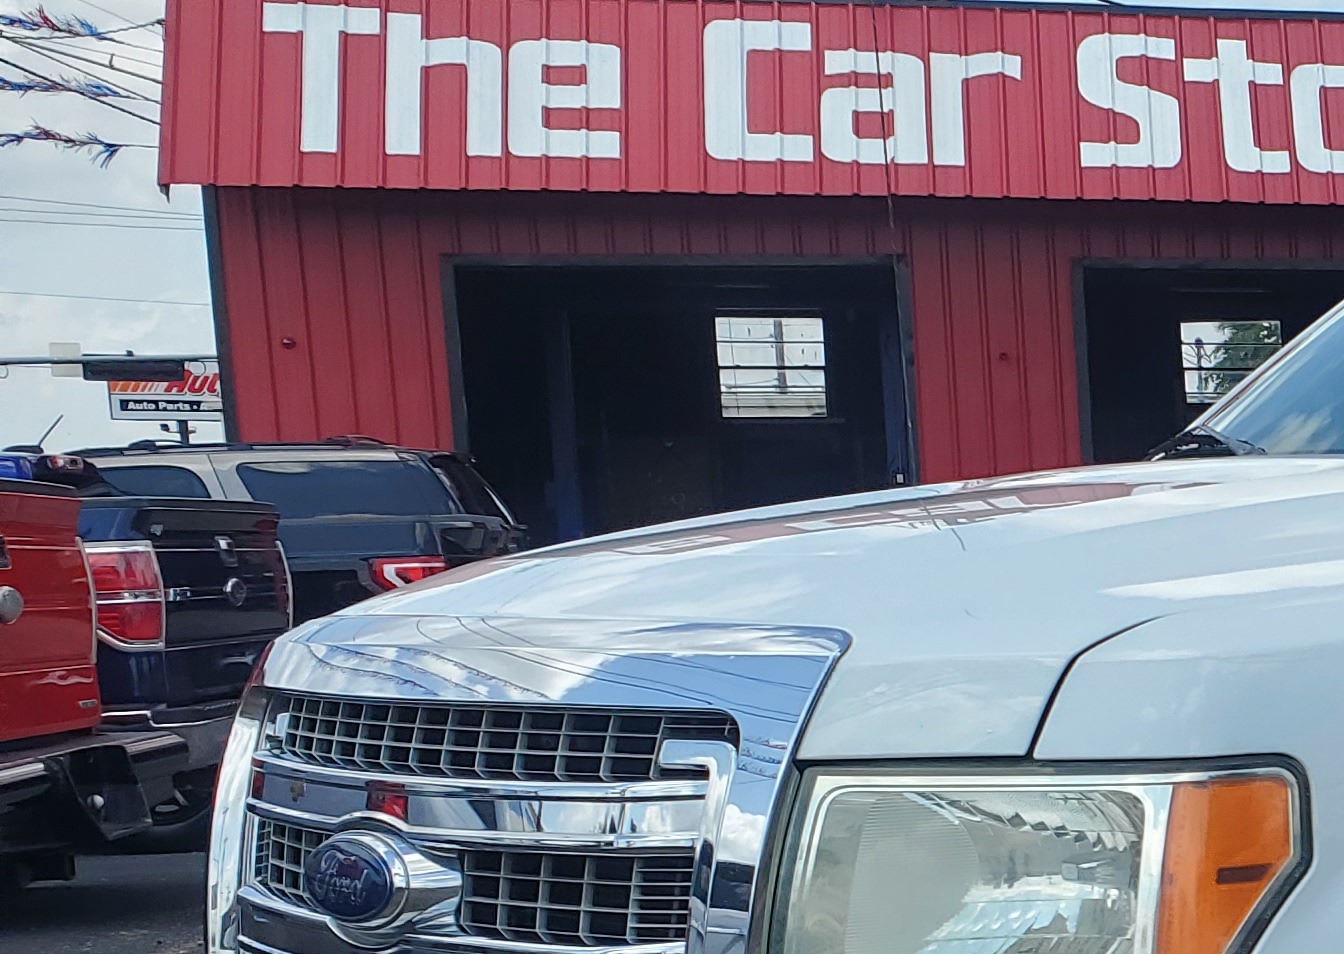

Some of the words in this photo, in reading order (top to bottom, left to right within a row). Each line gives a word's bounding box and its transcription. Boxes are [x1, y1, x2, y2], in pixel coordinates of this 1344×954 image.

[263, 2, 621, 159] The
[703, 18, 1021, 166] Car
[127, 401, 156, 410] Auto
[158, 402, 191, 410] Parts
[315, 849, 369, 905] Ford
